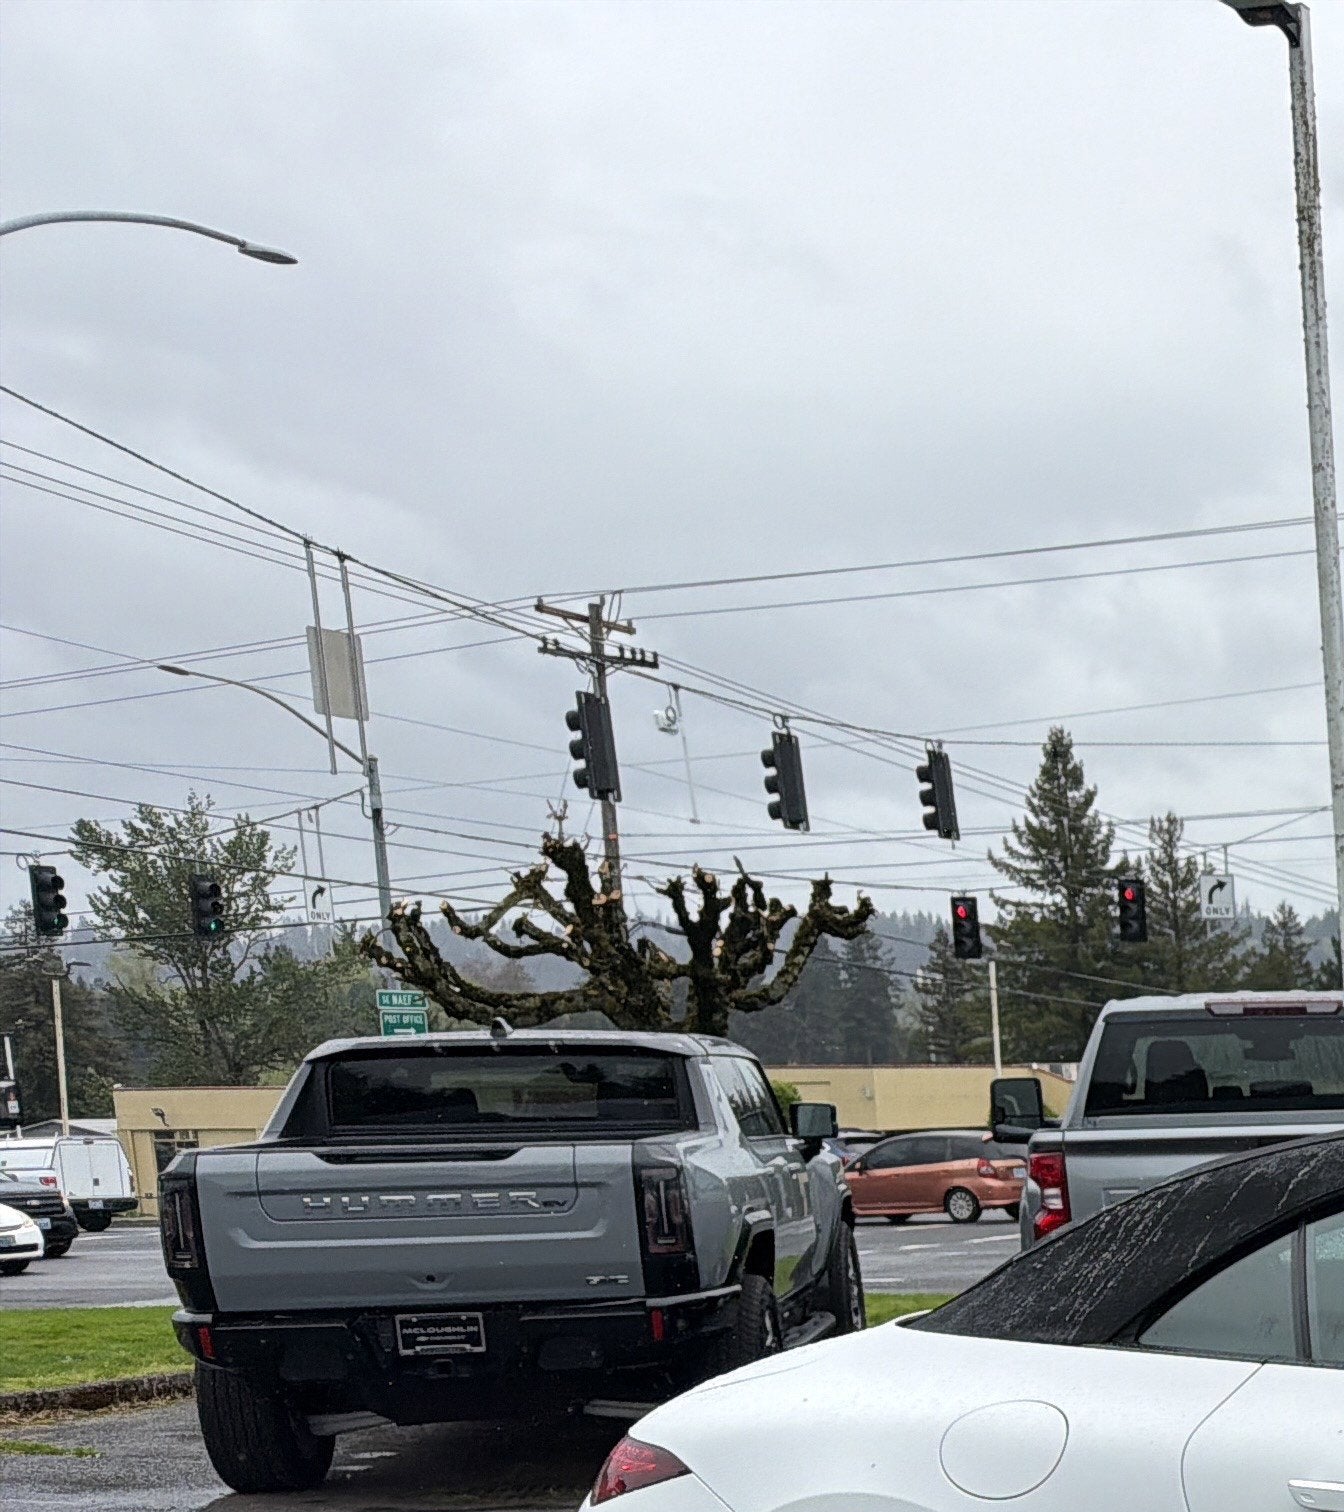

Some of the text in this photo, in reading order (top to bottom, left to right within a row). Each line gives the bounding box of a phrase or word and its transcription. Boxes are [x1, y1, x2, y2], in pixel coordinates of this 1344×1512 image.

[310, 911, 331, 920] ONLY
[1205, 906, 1230, 916] ONLY
[384, 1014, 424, 1024] POST OFFICE
[302, 1191, 541, 1213] HUMMER
[401, 1325, 479, 1334] MCLOUGHLIN
